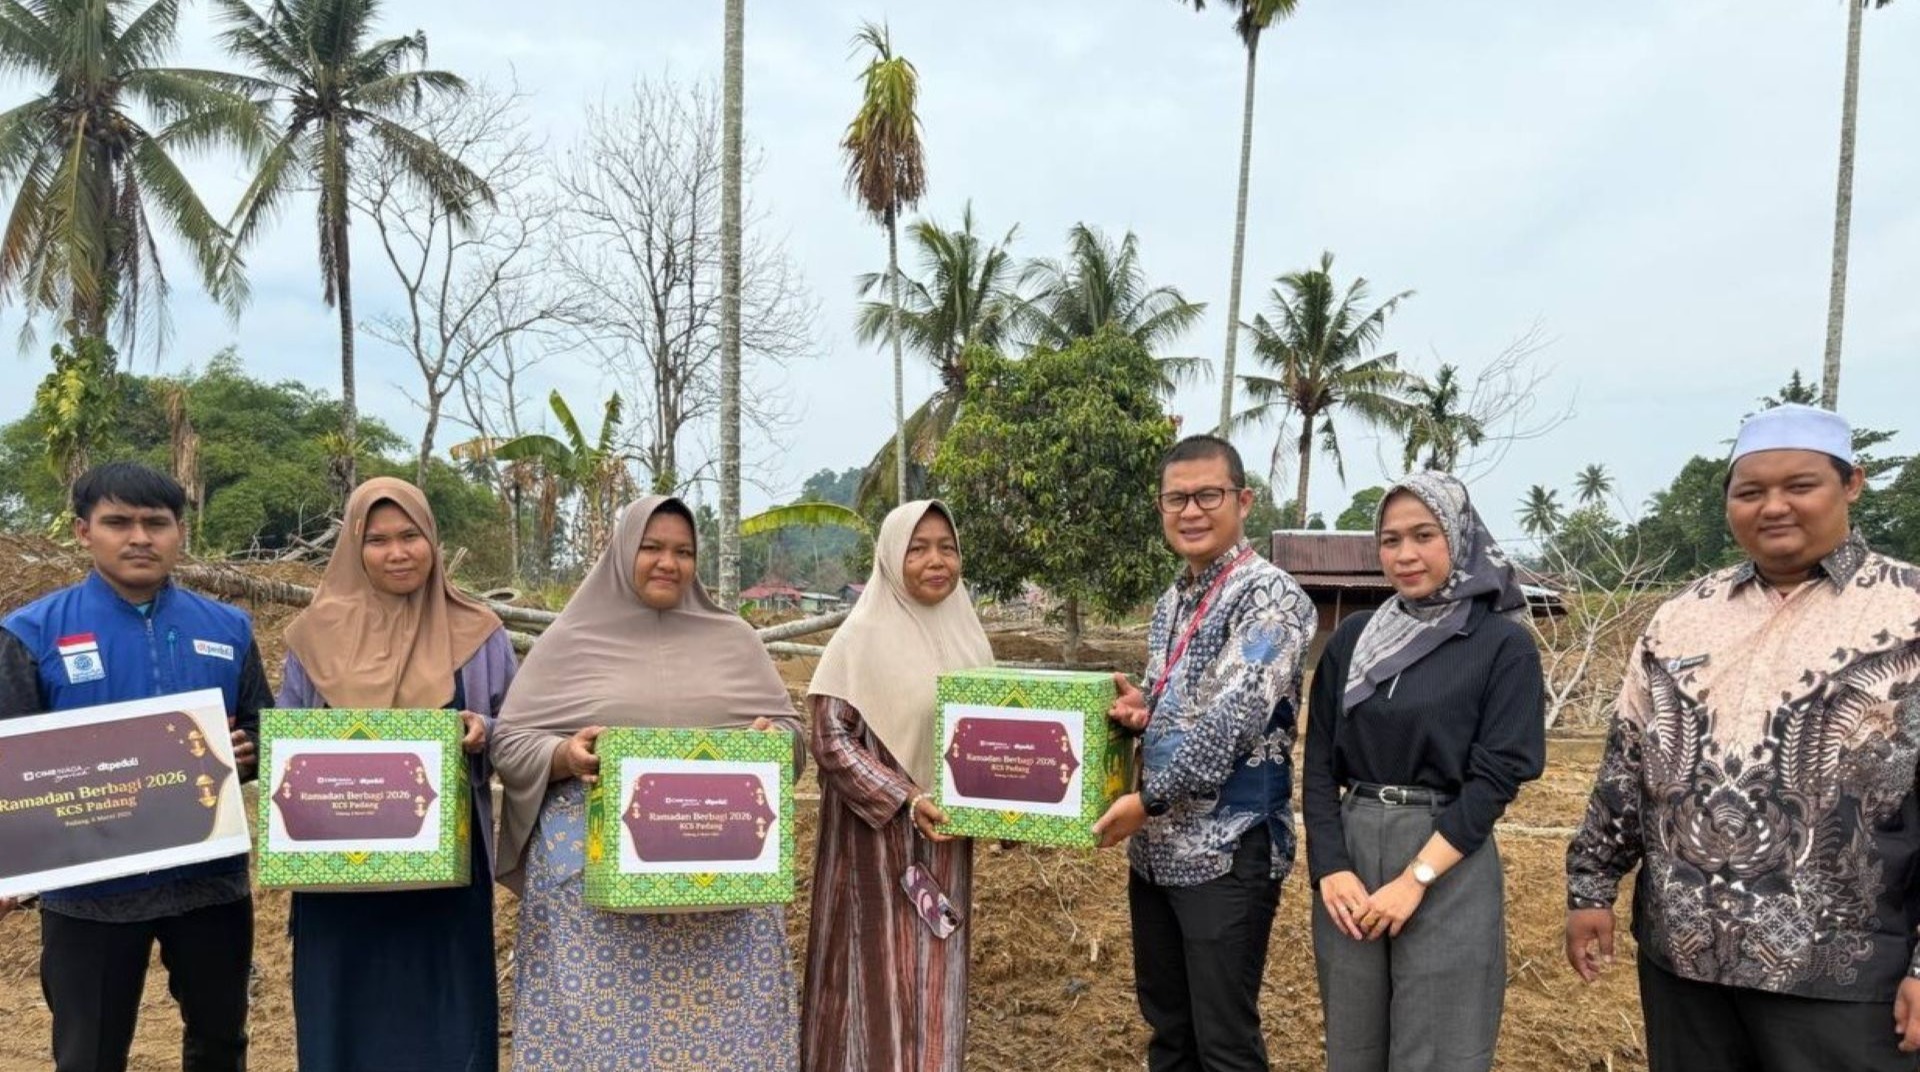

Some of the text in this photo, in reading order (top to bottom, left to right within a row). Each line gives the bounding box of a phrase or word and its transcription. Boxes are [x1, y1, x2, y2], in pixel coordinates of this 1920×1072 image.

[0, 770, 187, 812] Ramadan Berbagi 2026
[301, 790, 410, 801] Ramadan Berbagi 2026
[56, 795, 138, 817] KCS Padang
[649, 812, 692, 821] Ramadan
[729, 811, 752, 821] 2026
